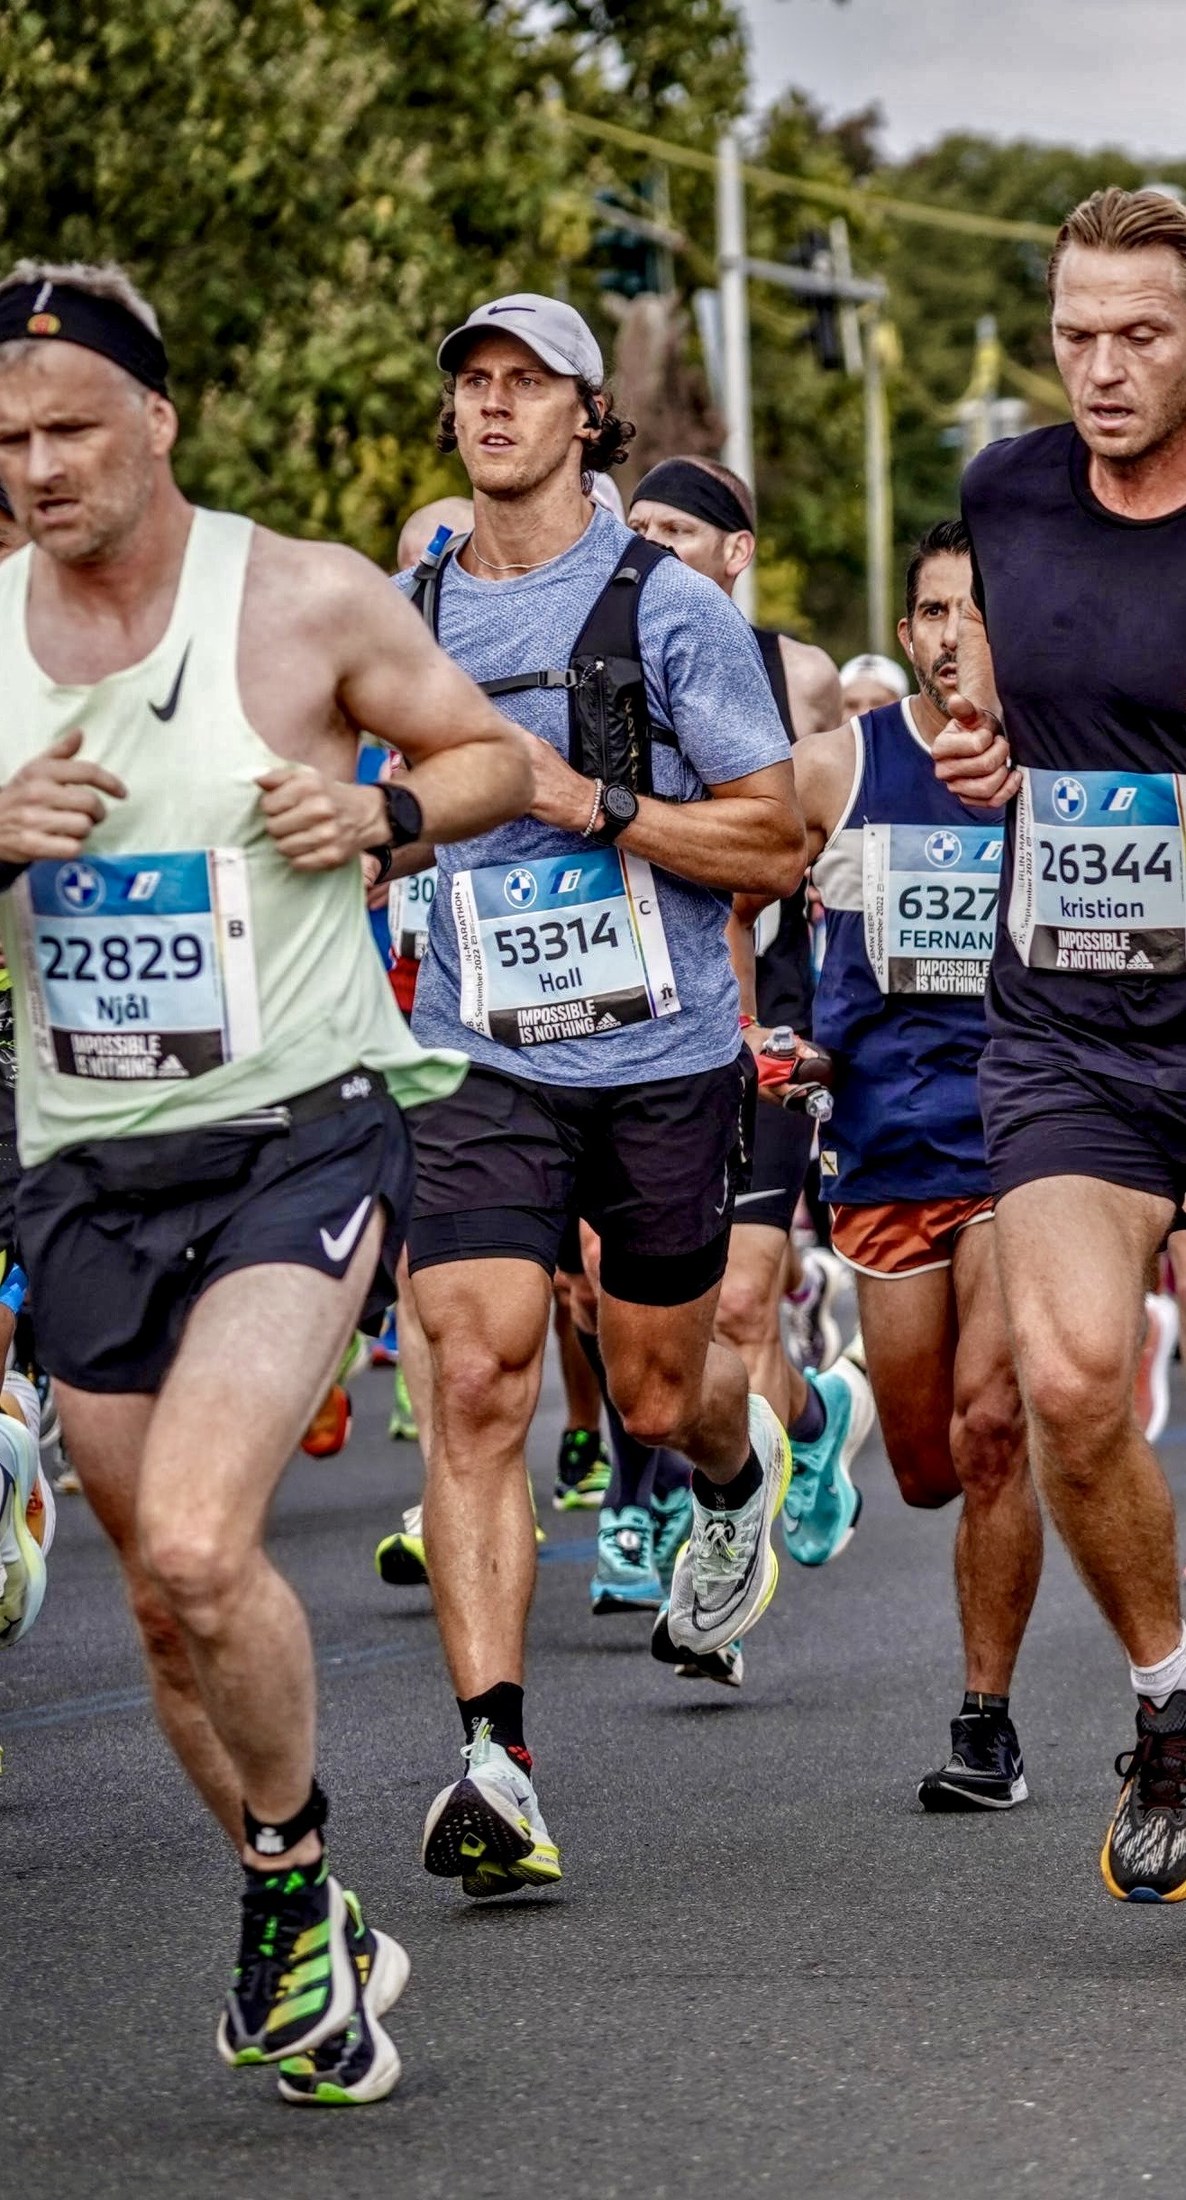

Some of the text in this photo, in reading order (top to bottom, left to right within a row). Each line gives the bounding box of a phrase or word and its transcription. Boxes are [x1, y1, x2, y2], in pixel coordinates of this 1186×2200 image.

[1025, 851, 1033, 876] 2022
[1040, 840, 1172, 884] 26344
[408, 875, 435, 903] 30
[639, 900, 651, 915] C
[876, 895, 884, 916] 2022
[899, 885, 1000, 921] 6327
[1060, 896, 1144, 918] kristian
[228, 921, 245, 938] B
[494, 911, 618, 969] 53314
[900, 929, 993, 950] FERNAN
[1057, 929, 1131, 951] IMPOSSIBLE
[40, 932, 204, 982] 22829
[916, 959, 990, 977] IMPOSSIBLE
[1056, 949, 1126, 970] IS NOTHING
[473, 948, 485, 1032] 25. September 2022
[539, 967, 583, 994] Hall
[916, 976, 986, 993] IS NOTHING
[517, 999, 597, 1027] IMPOSSIBLE
[519, 1017, 595, 1044] IS NOTHING
[70, 1033, 162, 1056] IMPOSSIBLE
